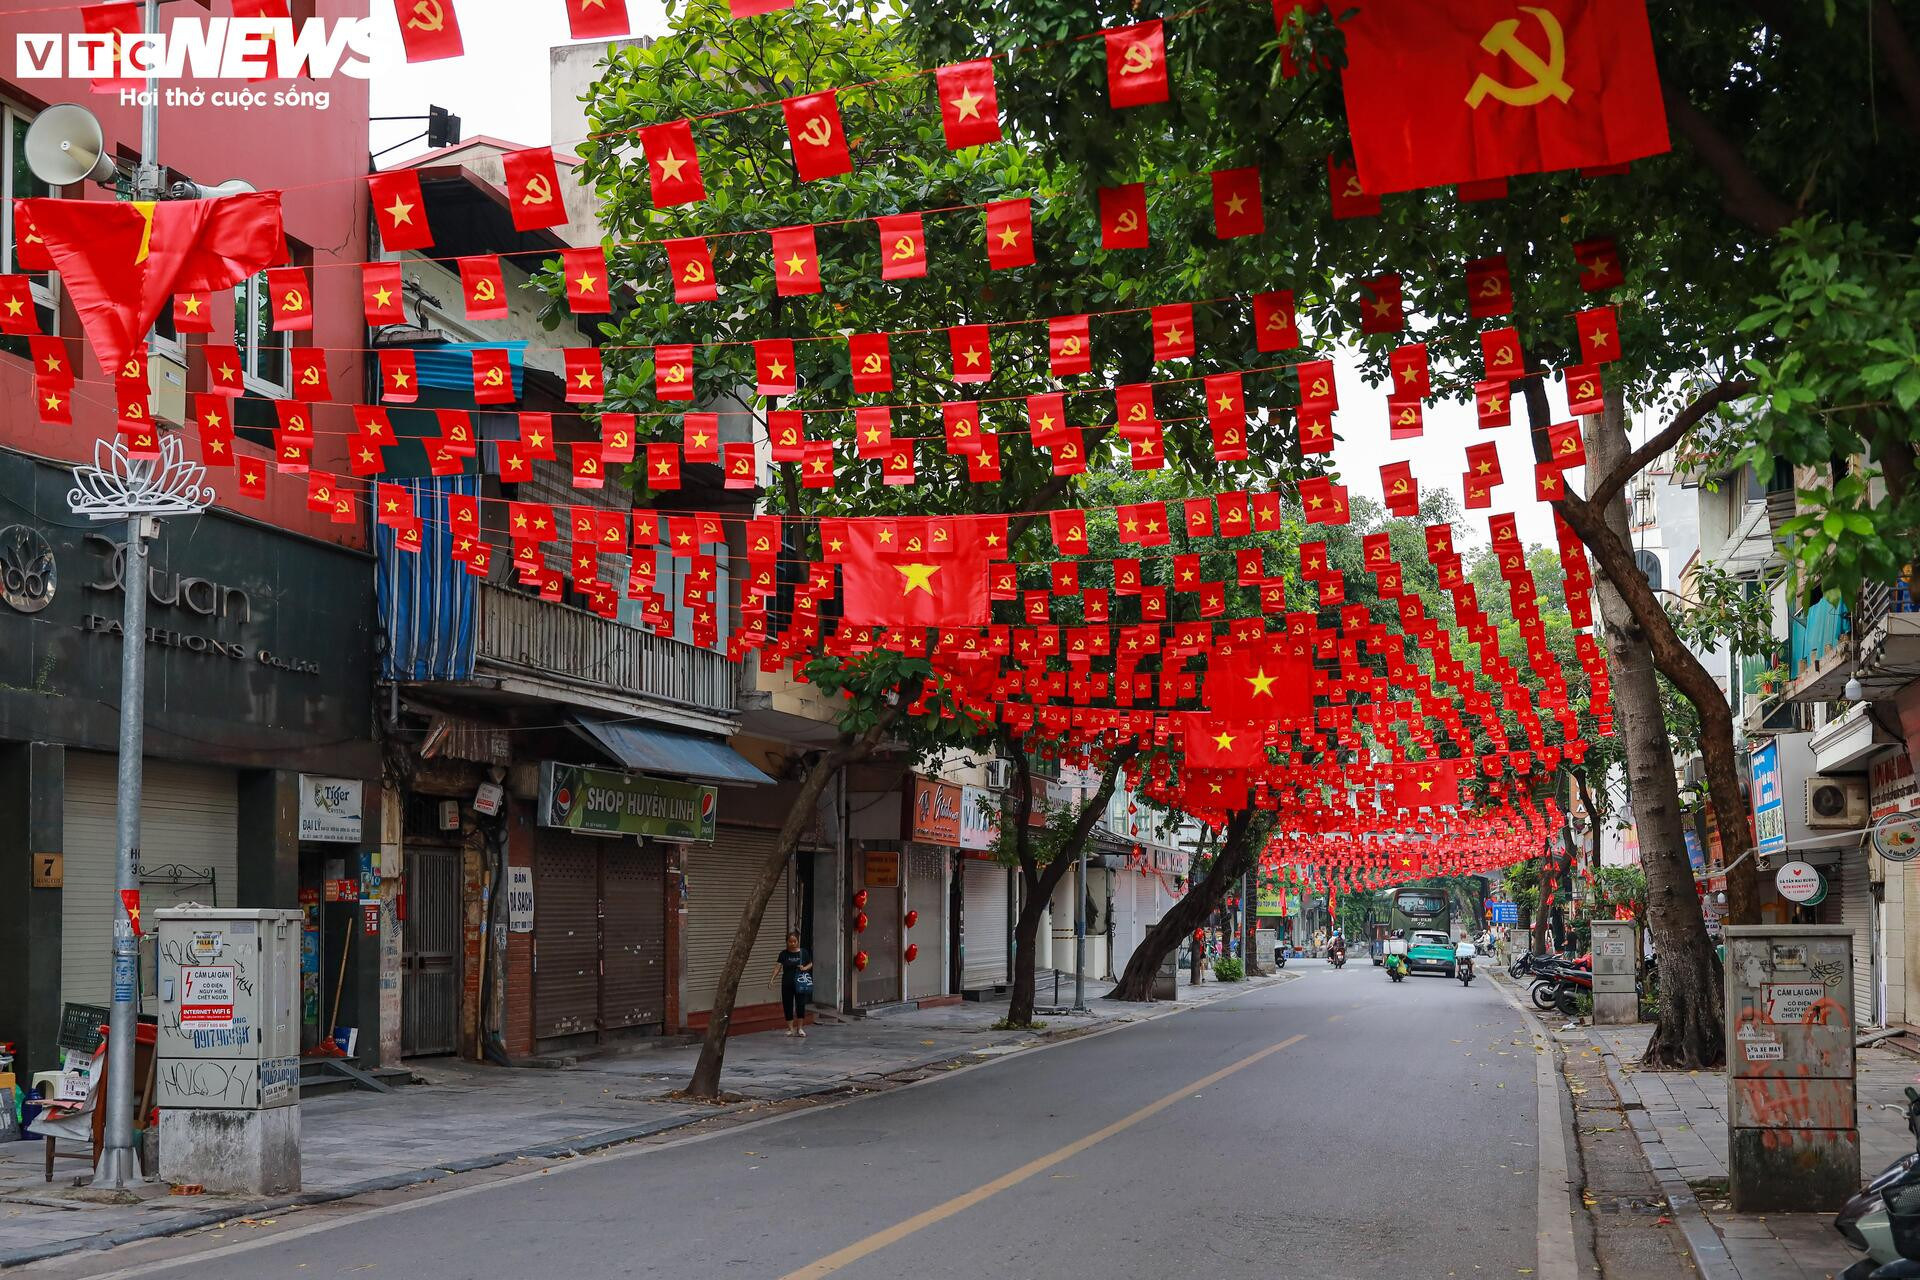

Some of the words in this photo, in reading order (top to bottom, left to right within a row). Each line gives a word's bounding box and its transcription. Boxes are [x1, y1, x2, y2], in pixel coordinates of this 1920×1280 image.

[84, 614, 246, 660] FAHIONS
[325, 786, 349, 806] Tiger
[587, 786, 624, 813] SHOP
[627, 785, 666, 819] HUYỀN
[44, 859, 55, 876] 7
[514, 873, 527, 884] BÁN
[518, 891, 533, 914] SẠCH
[194, 970, 207, 979] CẤM
[1777, 989, 1793, 997] CẤM
